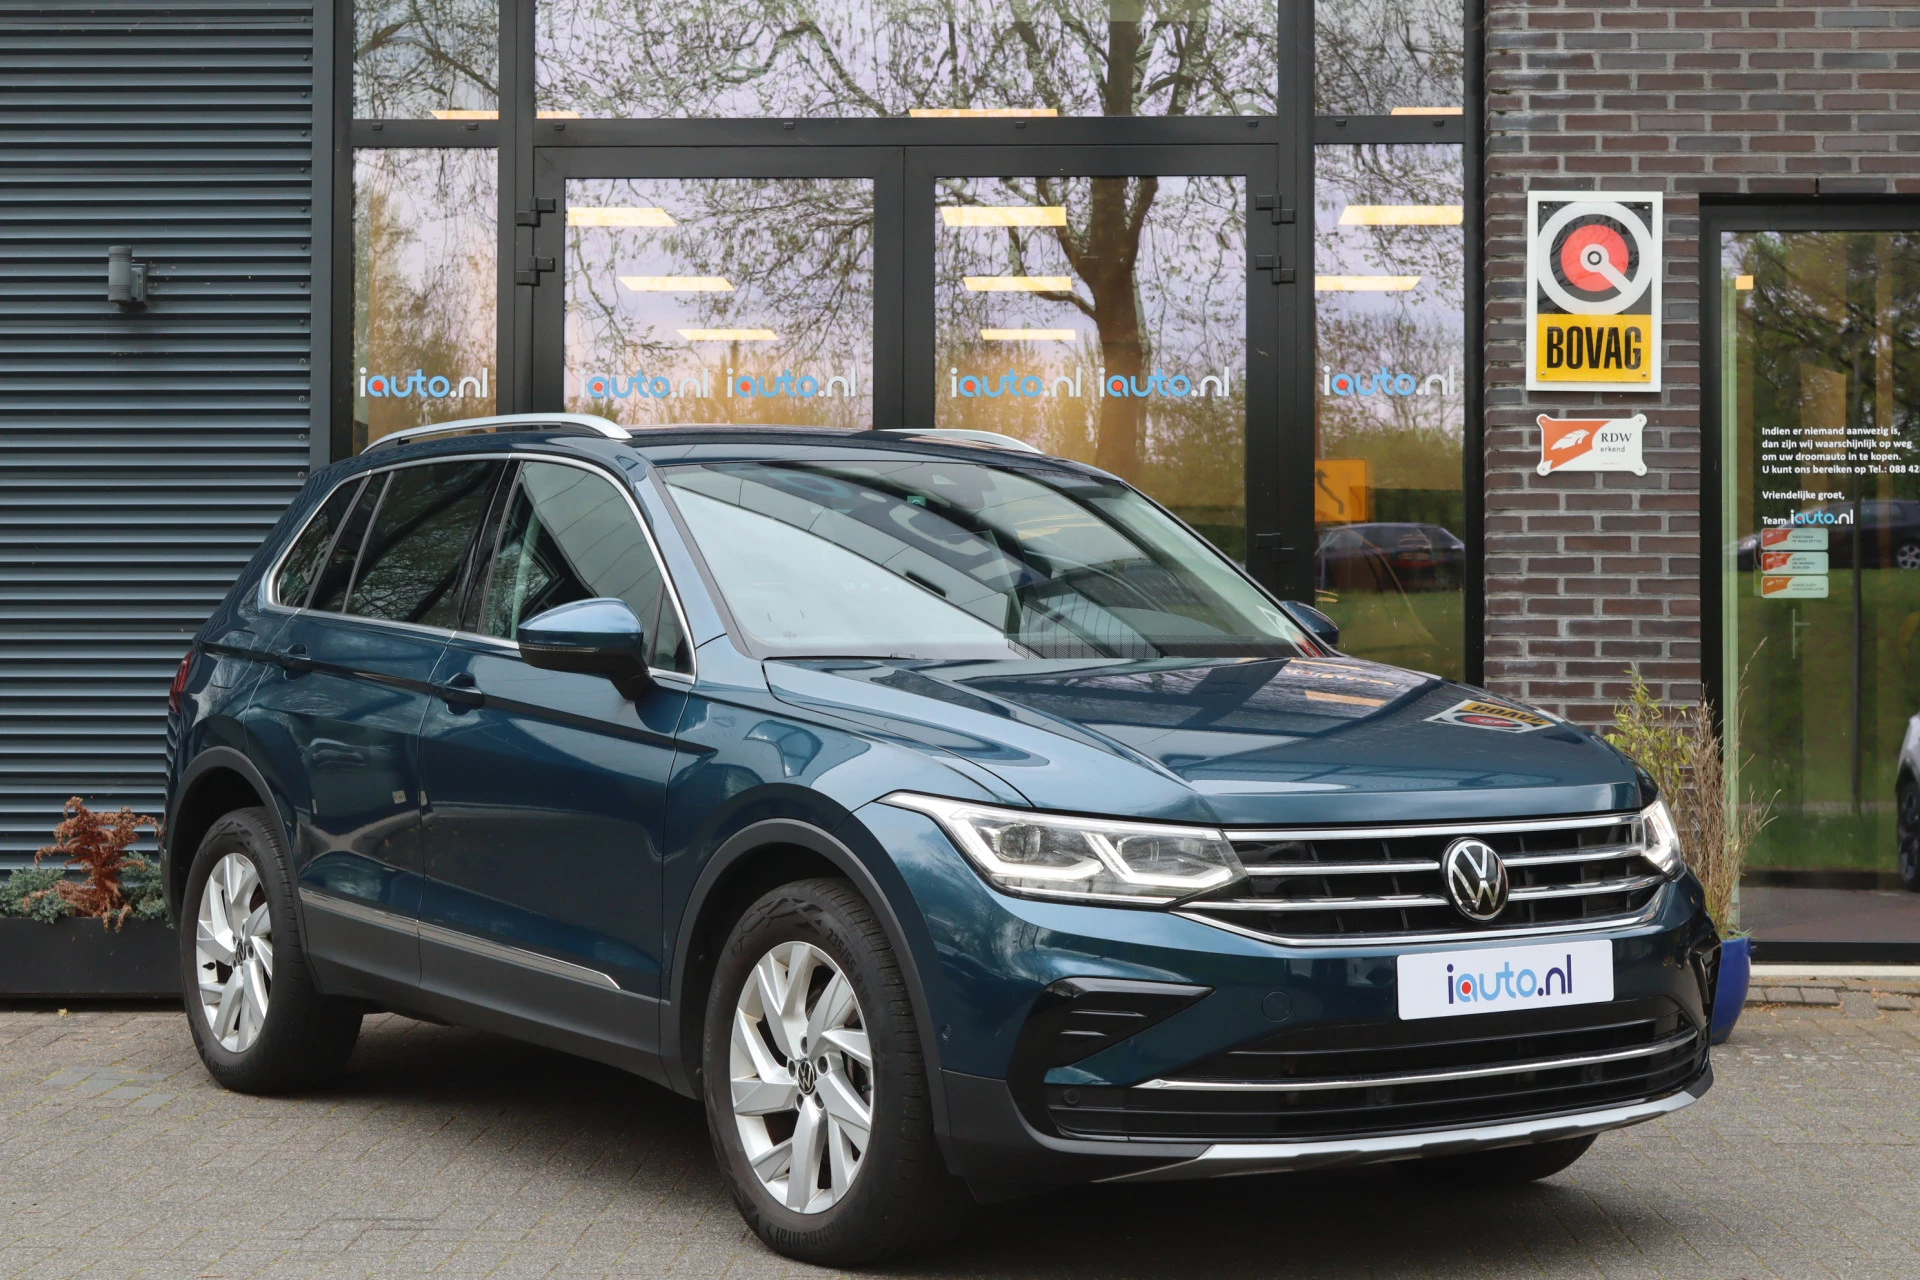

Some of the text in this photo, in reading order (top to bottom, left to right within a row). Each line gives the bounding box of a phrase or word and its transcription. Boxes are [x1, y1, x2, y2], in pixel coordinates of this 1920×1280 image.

[1547, 326, 1642, 370] BOVAG
[360, 367, 488, 398] iauto.nl
[580, 368, 709, 398] iauto.nl
[727, 368, 856, 398] iauto.nl
[951, 367, 1081, 397] iauto.nl
[1099, 366, 1230, 397] iauto.nl
[1323, 365, 1455, 396] iauto.nl
[1601, 432, 1633, 443] RDW
[1762, 427, 1790, 435] Indien
[1804, 426, 1844, 435] niemand
[1846, 426, 1888, 436] aanwezig
[1890, 426, 1901, 436] is,
[1762, 439, 1912, 449] dan zijn wij waarschijnlijk op weg
[1600, 445, 1626, 453] erkend
[1795, 452, 1846, 460] droomauto
[1848, 452, 1857, 460] in
[1871, 452, 1901, 462] kopen.
[1762, 465, 1769, 473] U
[1771, 465, 1793, 473] kunt
[1813, 465, 1852, 473] bereiken
[1854, 466, 1867, 475] op
[1868, 465, 1887, 473] Tel.:
[1889, 465, 1906, 473] 088
[1908, 465, 1920, 473] 42
[1762, 491, 1845, 500] Vriendelijke groet,
[1762, 509, 1854, 525] Team iauto.nl
[1446, 954, 1573, 1005] iauto.nl
[776, 1216, 848, 1248] ontinental
